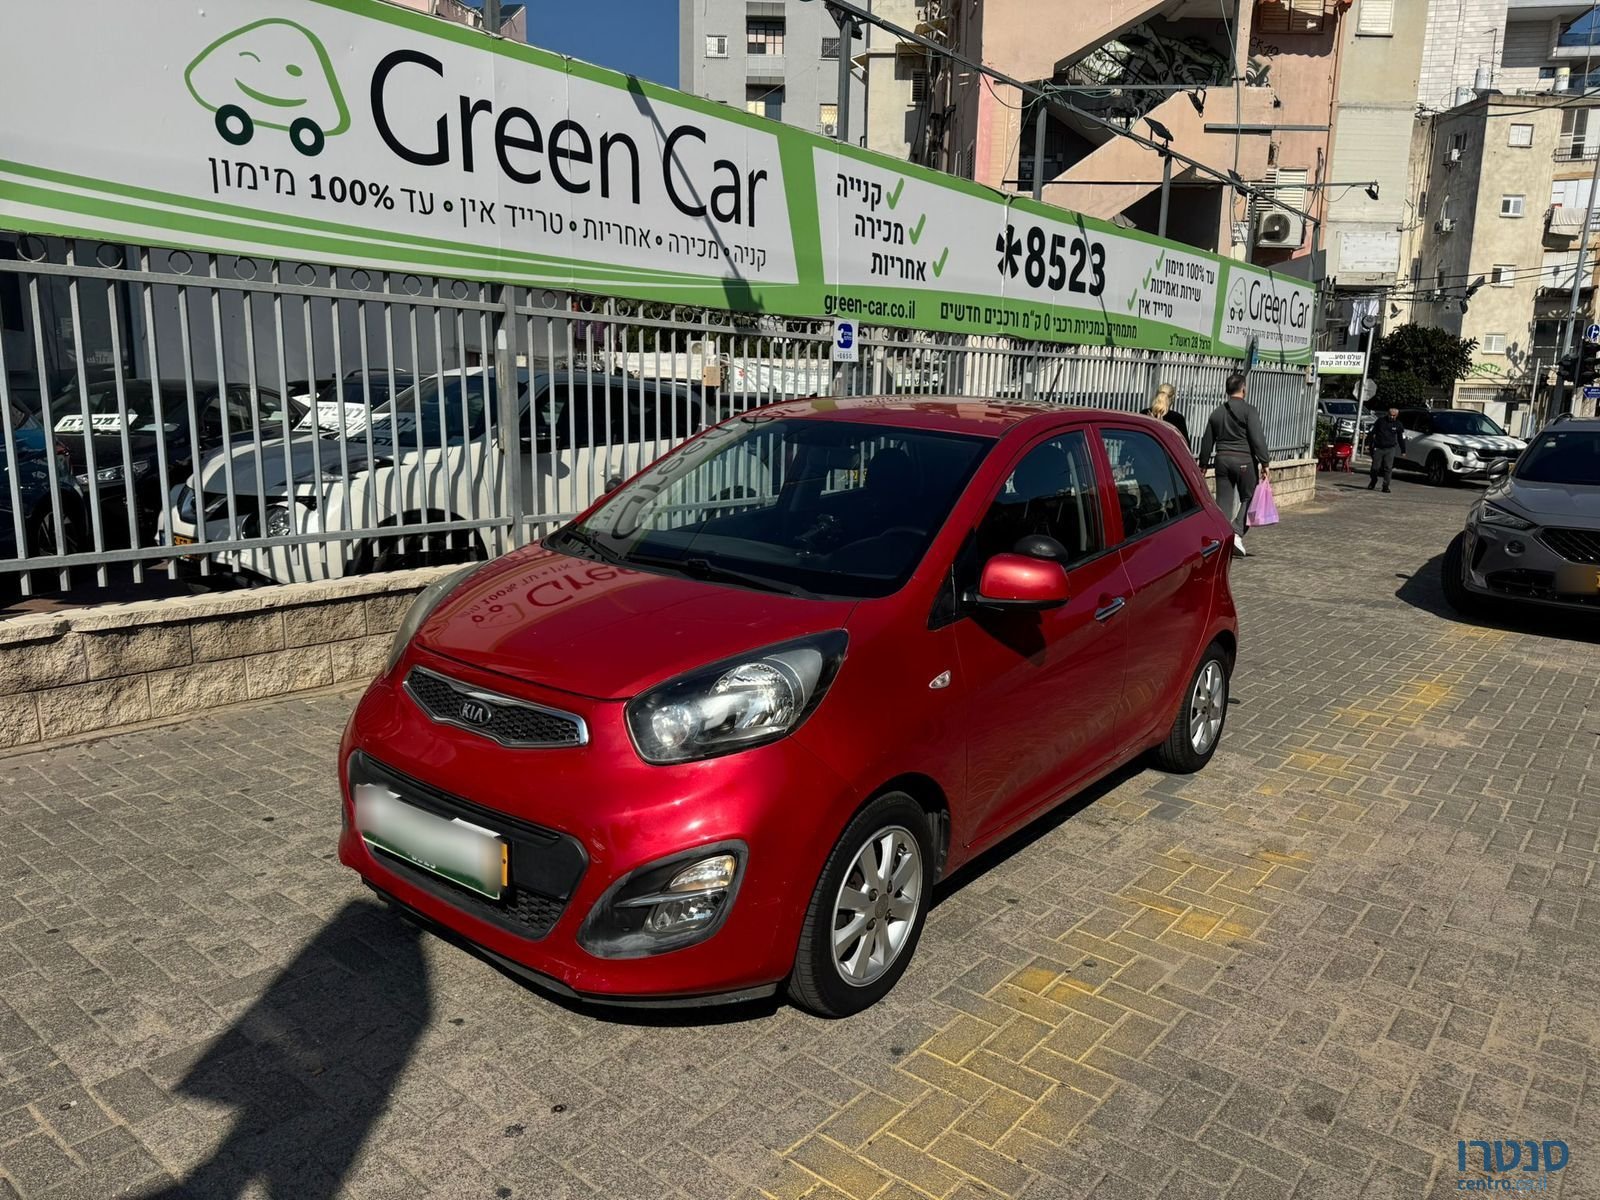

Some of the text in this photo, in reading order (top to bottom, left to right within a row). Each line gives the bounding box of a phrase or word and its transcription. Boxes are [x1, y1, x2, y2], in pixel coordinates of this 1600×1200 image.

[370, 49, 768, 228] Green Car
[836, 173, 882, 212] קנייה
[208, 157, 767, 272] קניה מכירה אחריות טרייד אין עד 100% מימון
[855, 213, 904, 245] מכירה
[871, 252, 927, 282] אחריות
[1165, 258, 1215, 285] עד 100% מימון
[1150, 278, 1201, 302] שירות ואמינות
[824, 294, 916, 320] green-car.co.il
[940, 302, 981, 324] חדשים
[985, 307, 1019, 328] ורכבים
[1138, 298, 1173, 318] טרייד אין
[1249, 280, 1310, 330] Green Car
[1053, 316, 1072, 333] רכבי
[1074, 317, 1105, 336] במכירת
[462, 702, 483, 722] KIA
